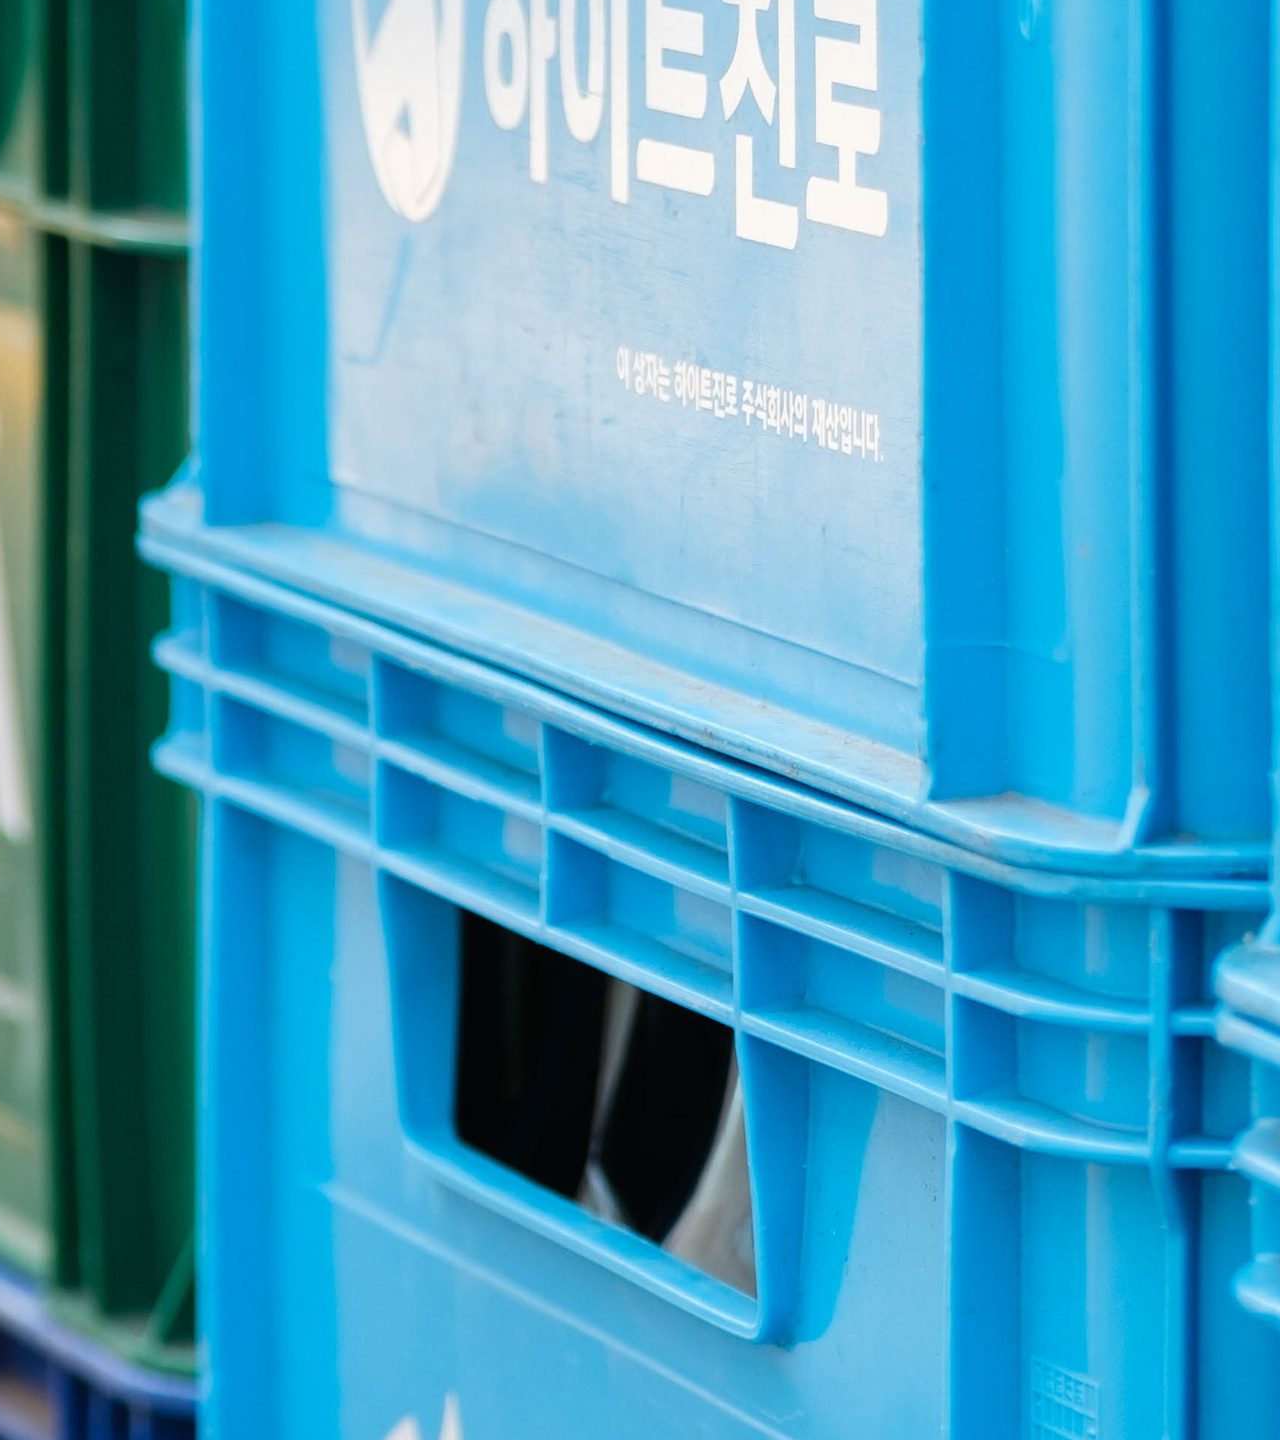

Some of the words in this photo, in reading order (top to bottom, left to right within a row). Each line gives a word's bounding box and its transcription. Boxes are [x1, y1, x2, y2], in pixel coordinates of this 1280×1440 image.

[616, 346, 630, 390] 이
[633, 351, 671, 403] 상자는
[673, 360, 738, 419] 하이트진로
[741, 380, 808, 442] 주식회사의
[811, 398, 885, 463] 재산입니다.
